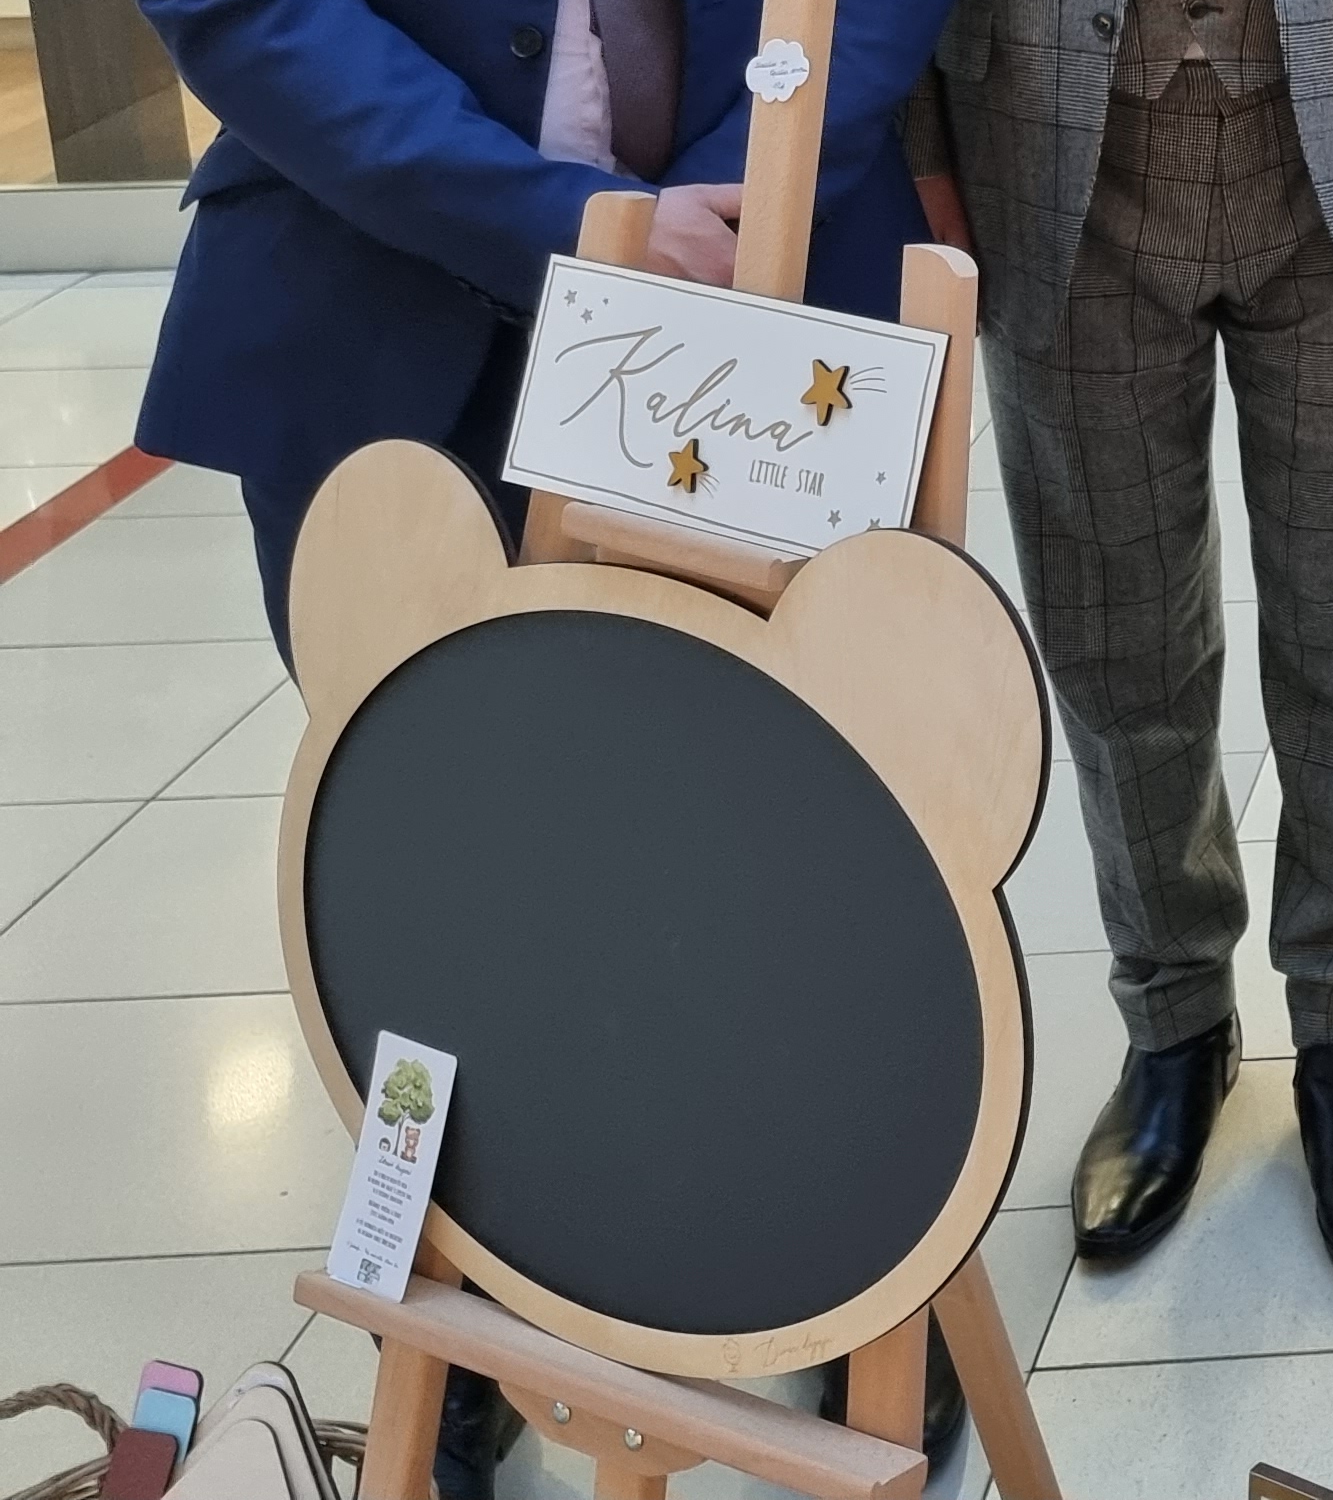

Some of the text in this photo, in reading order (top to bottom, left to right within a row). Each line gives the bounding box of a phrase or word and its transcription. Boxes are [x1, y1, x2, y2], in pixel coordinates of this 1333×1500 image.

[555, 325, 814, 469] Kalina
[749, 459, 826, 498] LITTLE STAR
